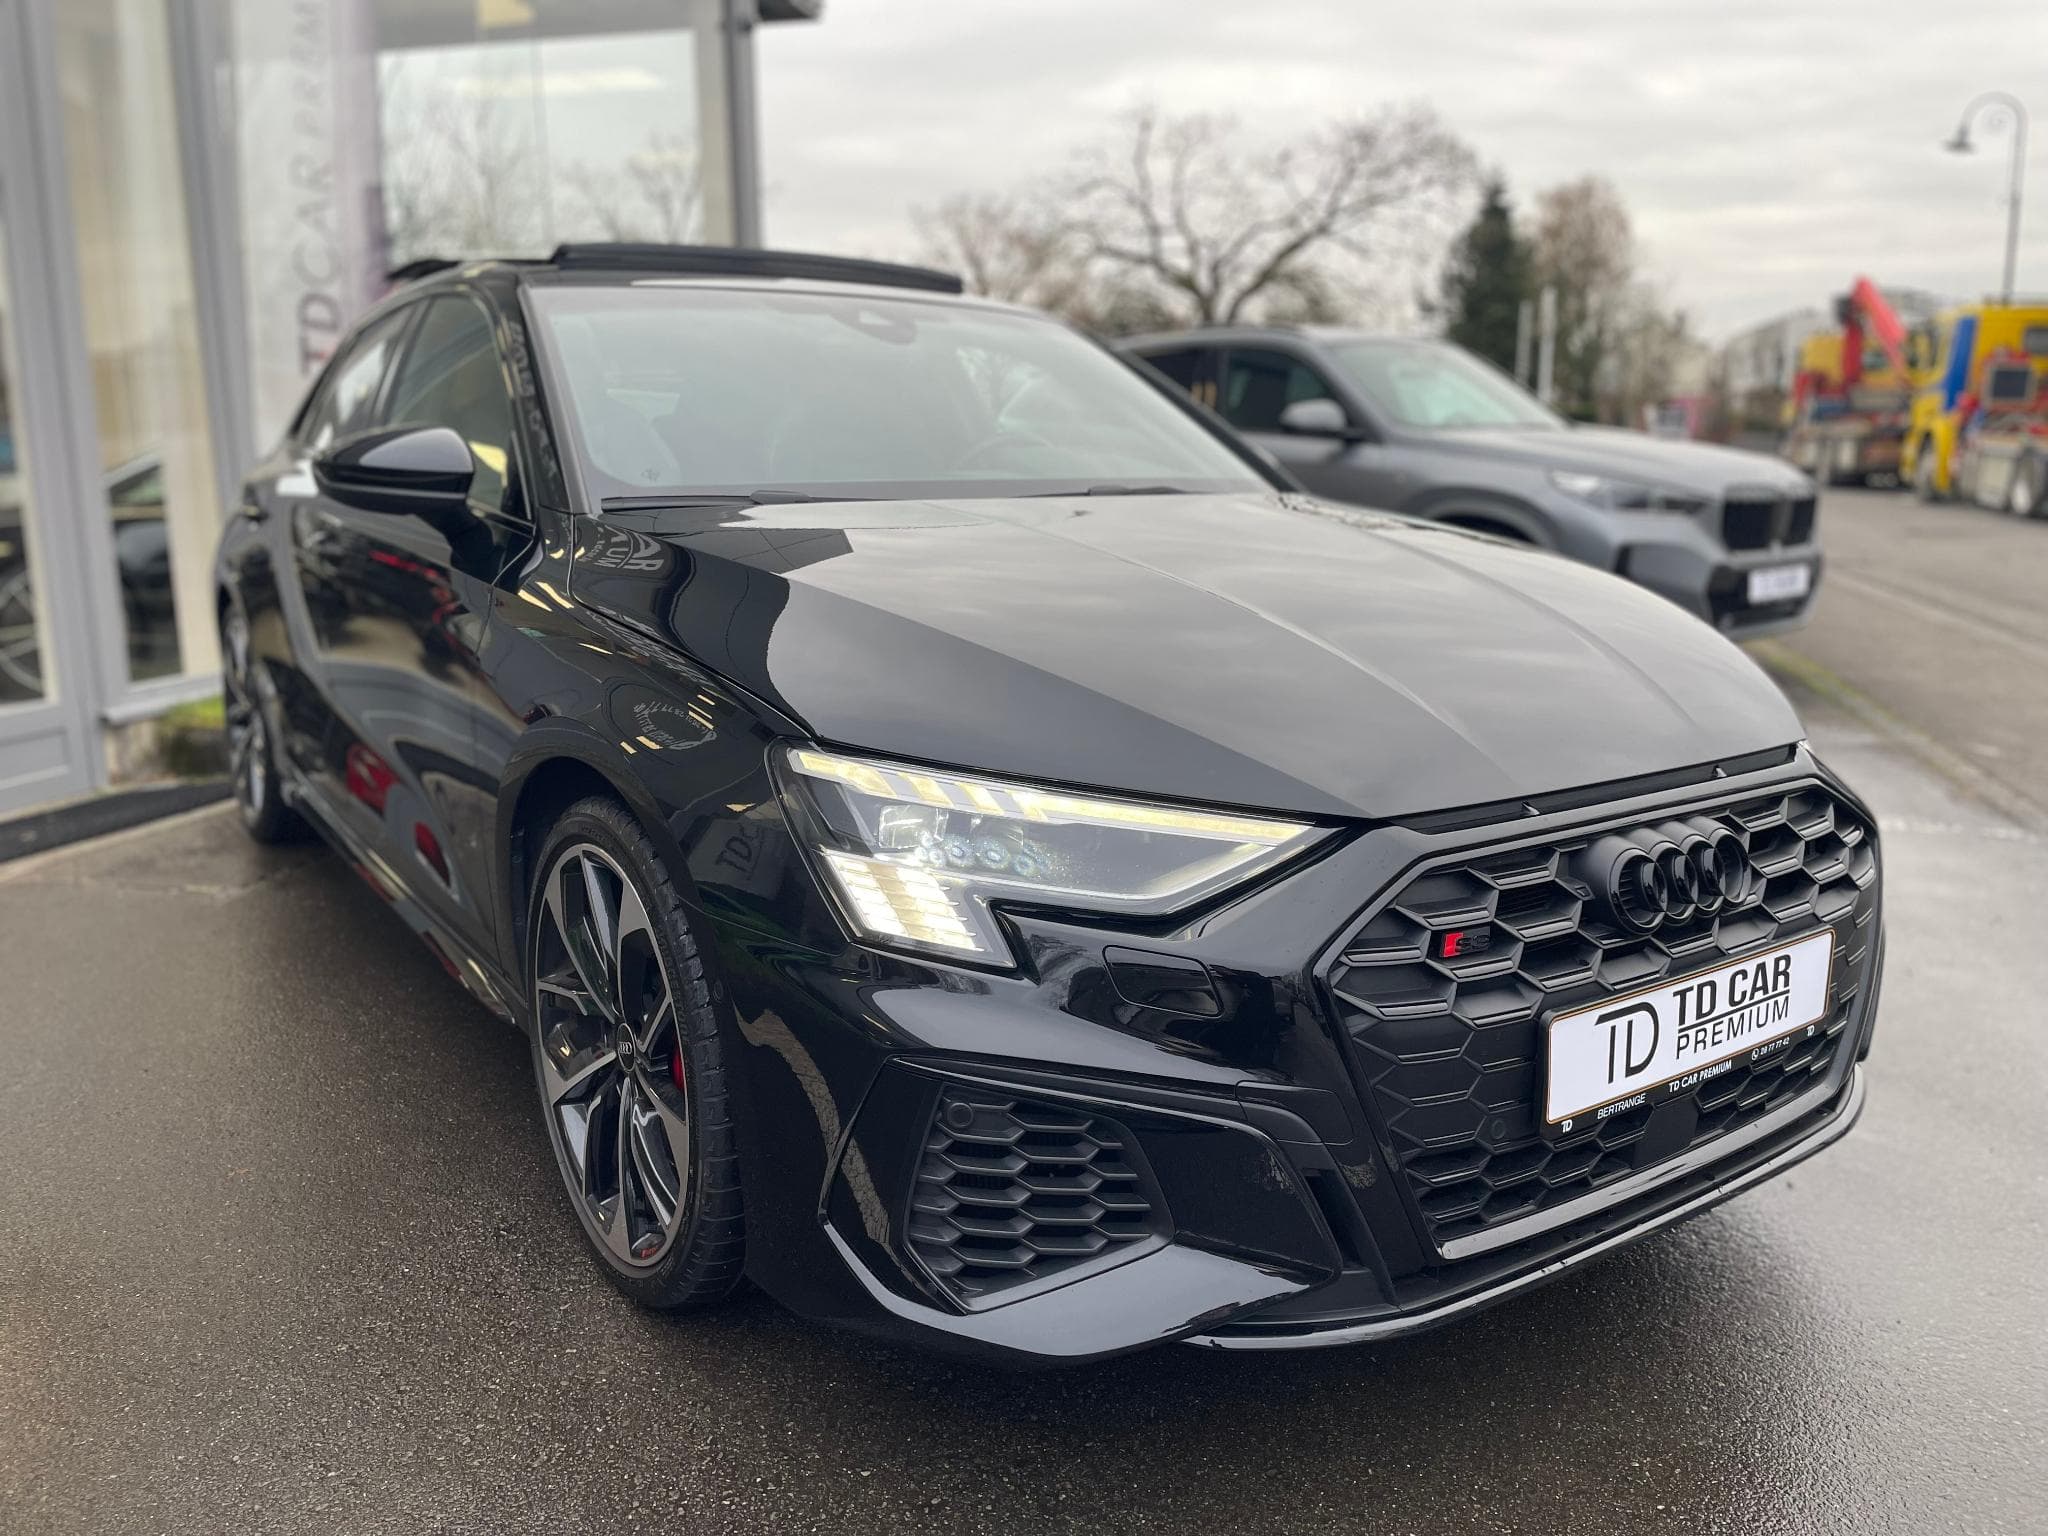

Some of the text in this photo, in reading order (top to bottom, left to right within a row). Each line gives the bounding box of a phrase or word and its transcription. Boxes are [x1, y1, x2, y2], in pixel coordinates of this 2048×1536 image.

[1673, 954, 1792, 1027] TD CAR
[1676, 995, 1790, 1060] PREMIUM
[1669, 1059, 1732, 1093] TD CAR PREMIUM
[1597, 1093, 1647, 1119] BERTRANGE
